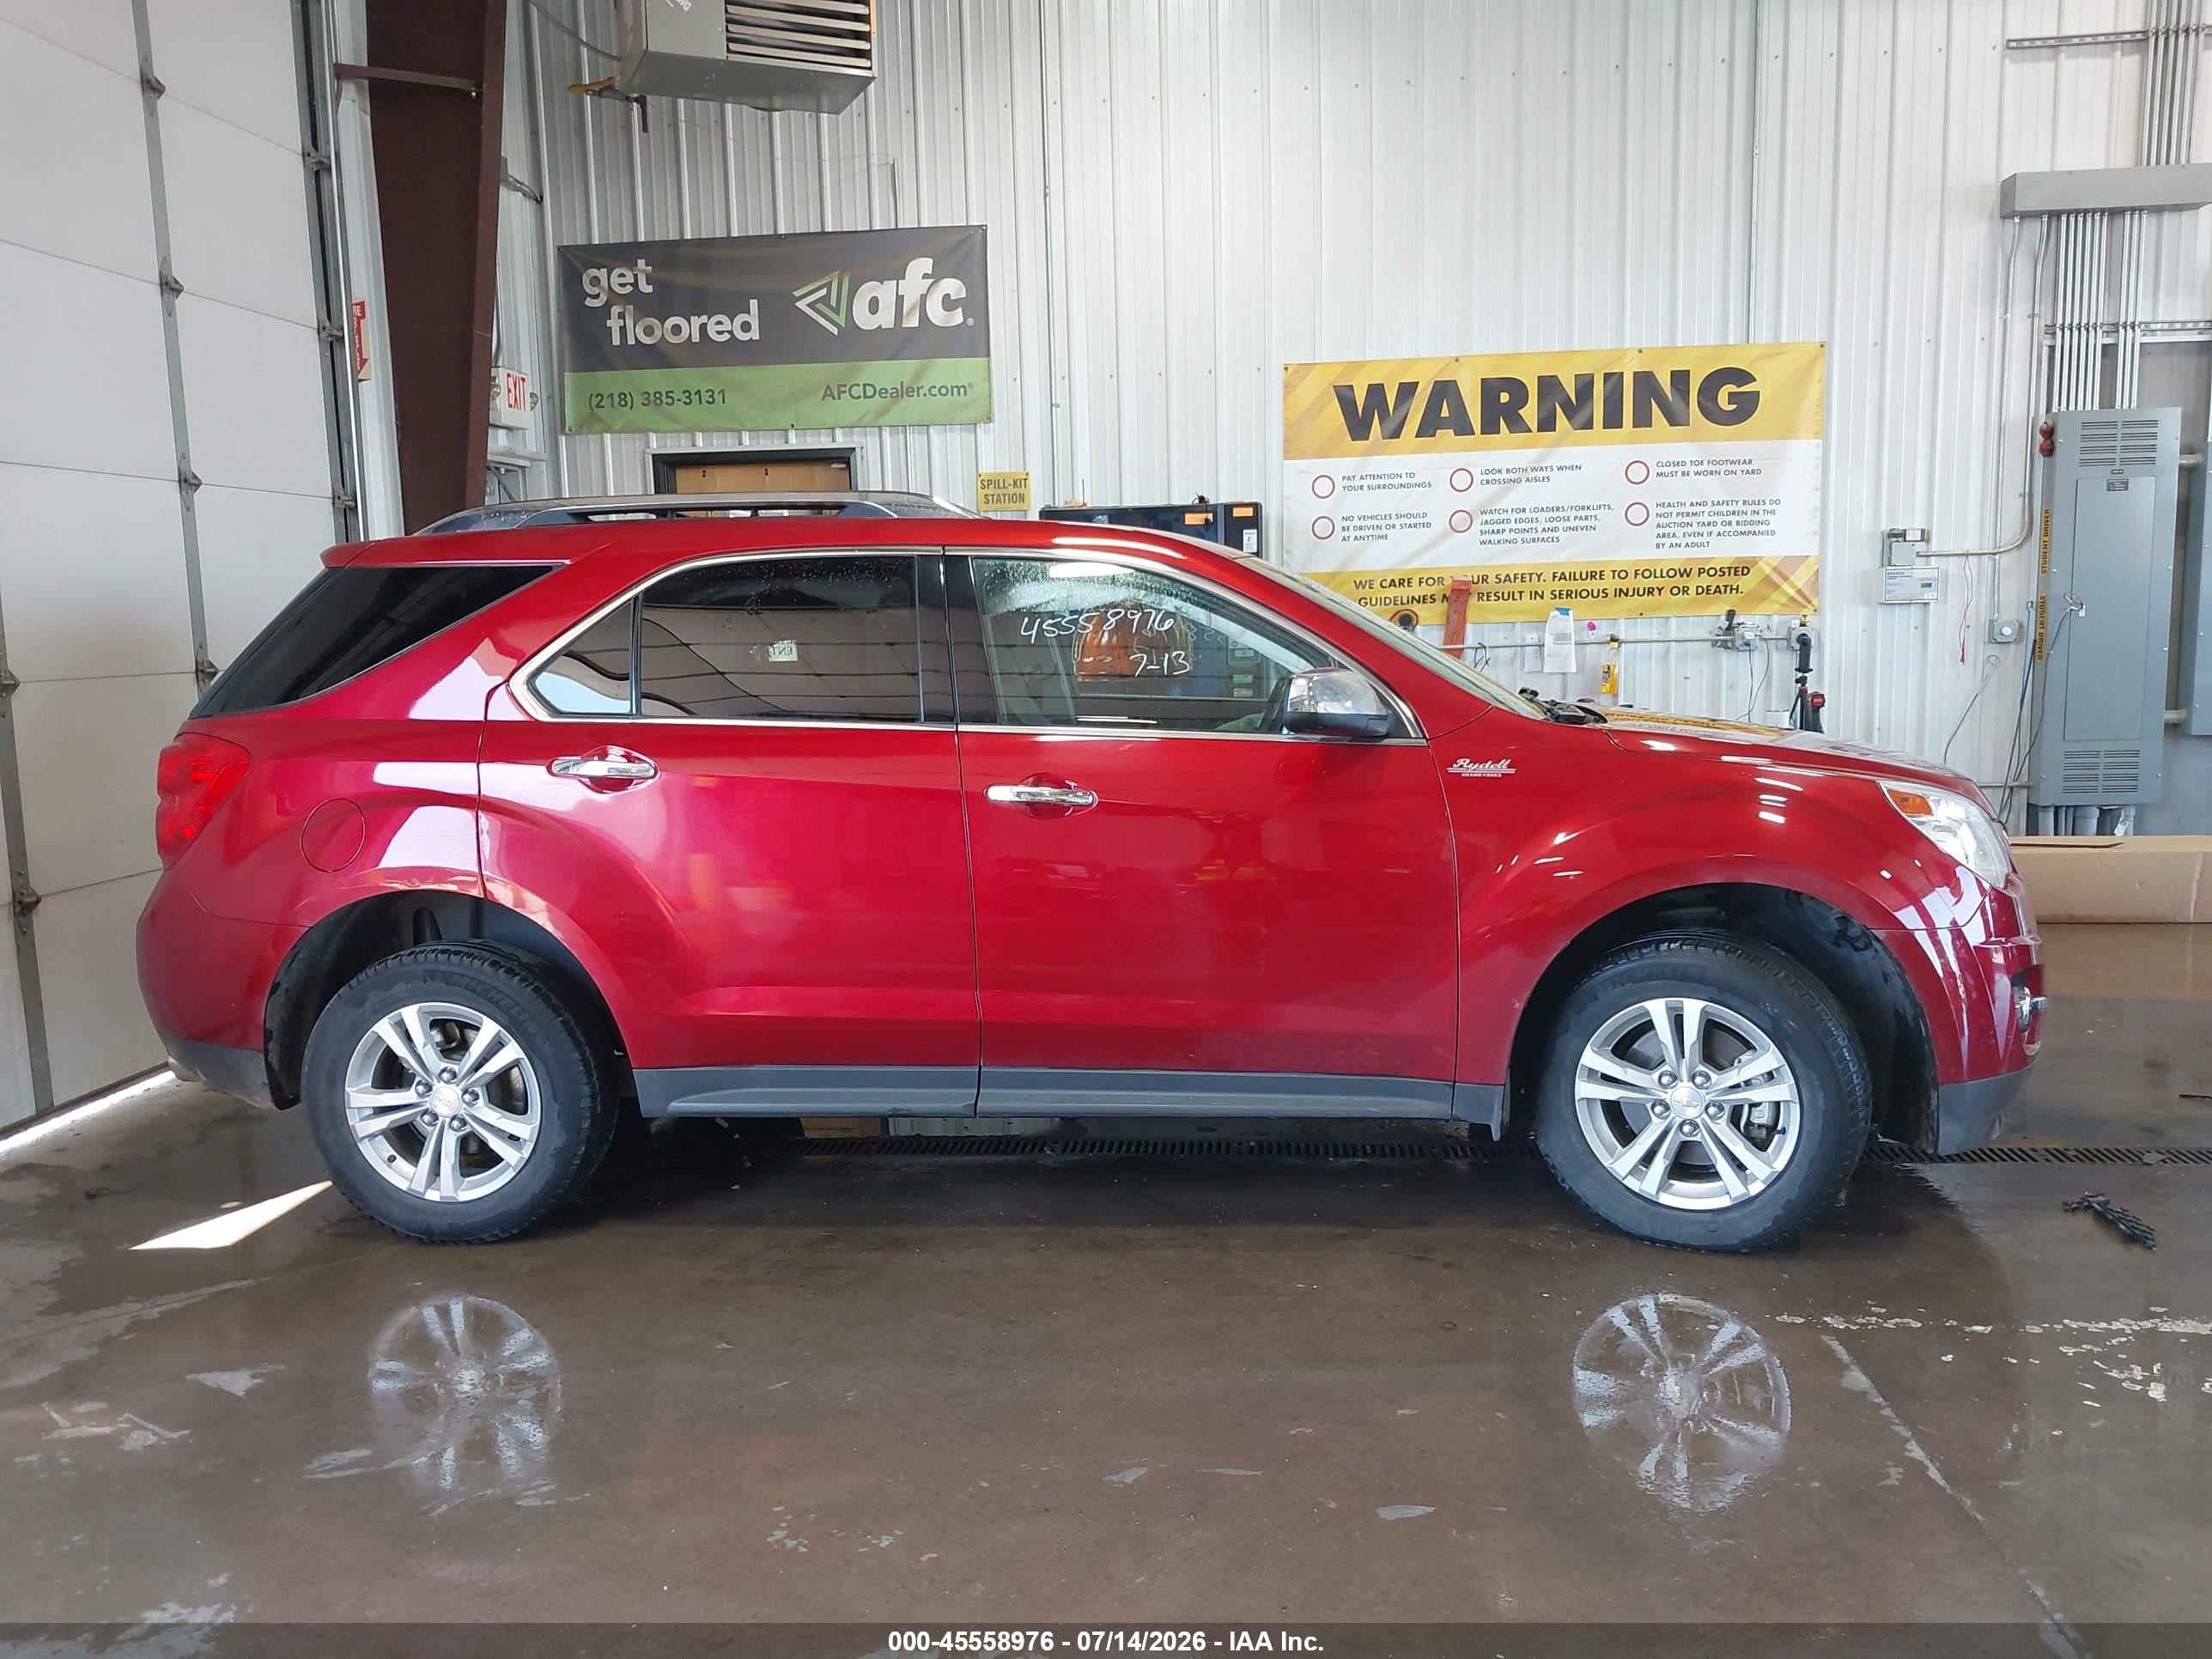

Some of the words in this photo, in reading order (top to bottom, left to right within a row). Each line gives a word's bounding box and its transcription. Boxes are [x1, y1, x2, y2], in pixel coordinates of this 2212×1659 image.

[581, 259, 653, 307] get
[852, 258, 967, 331] afc
[606, 299, 760, 346] floored
[506, 373, 526, 412] EXIT
[821, 382, 968, 401] AFCDealer.com
[588, 391, 634, 410] (218)
[641, 388, 726, 407] 385-3131
[1332, 367, 1760, 441] WARNING
[1480, 467, 1503, 476] LOOK
[1505, 466, 1528, 475] BOTH
[1530, 465, 1554, 473] WAYS
[1556, 464, 1582, 472] WHEN
[1656, 470, 1679, 478] MUST
[980, 477, 1029, 490] SPILL-KIT
[1358, 472, 1402, 482] ATTENTION
[1480, 477, 1522, 486] CROSSING
[1524, 475, 1551, 483] AISLES
[1366, 481, 1432, 491] SURROUNDINGS
[983, 492, 1025, 505] STATION
[1656, 501, 1686, 509] HEALTH
[1711, 499, 1740, 507] SAFETY
[1742, 498, 1766, 507] RULES
[1480, 507, 1509, 516] WATCH
[1510, 507, 1527, 515] FOR
[1529, 503, 1614, 514] LOADERS/FORKLIFTS,
[1656, 511, 1674, 520] NOT
[1675, 510, 1705, 519] PERMIT
[1707, 509, 1748, 518] CHILDREN
[1341, 514, 1355, 523] NO
[1357, 513, 1393, 522] VEHICLES
[1395, 512, 1428, 520] SHOULD
[1480, 518, 1512, 526] JAGGED
[1544, 515, 1571, 524] LOOSE
[1573, 514, 1601, 522] PARTS,
[1735, 519, 1771, 527] BIDDING
[1352, 524, 1382, 532] DRIVEN
[1399, 521, 1431, 530] STARTED
[1480, 528, 1506, 537] SHARP
[1509, 526, 1539, 535] POINTS
[1562, 524, 1596, 532] UNEVEN
[1353, 533, 1389, 542] ANYTIME
[1716, 529, 1776, 538] ACCOMPANIED
[1479, 538, 1518, 546] WALKING
[1521, 536, 1560, 544] SURFACES
[1353, 579, 1375, 590] WE
[1379, 577, 1413, 589] CARE
[1418, 576, 1445, 587] FOR
[1449, 574, 1490, 585] UR
[1494, 572, 1547, 585] SAFETY.
[1552, 569, 1606, 582] FAILURE
[1610, 568, 1629, 580] TO
[1634, 567, 1693, 580] FOLLOW
[1698, 565, 1751, 578] POSTED
[1358, 593, 1437, 608] GUIDELINES
[1477, 590, 1525, 603] RESULT
[1529, 590, 1545, 601] IN
[1550, 587, 1609, 600] SERIOUS
[1613, 586, 1665, 599] INJURY
[1669, 585, 1690, 597] OR
[1695, 583, 1743, 596] DEATH.
[1020, 608, 1175, 644] 45558976
[1129, 650, 1189, 678] 7-13
